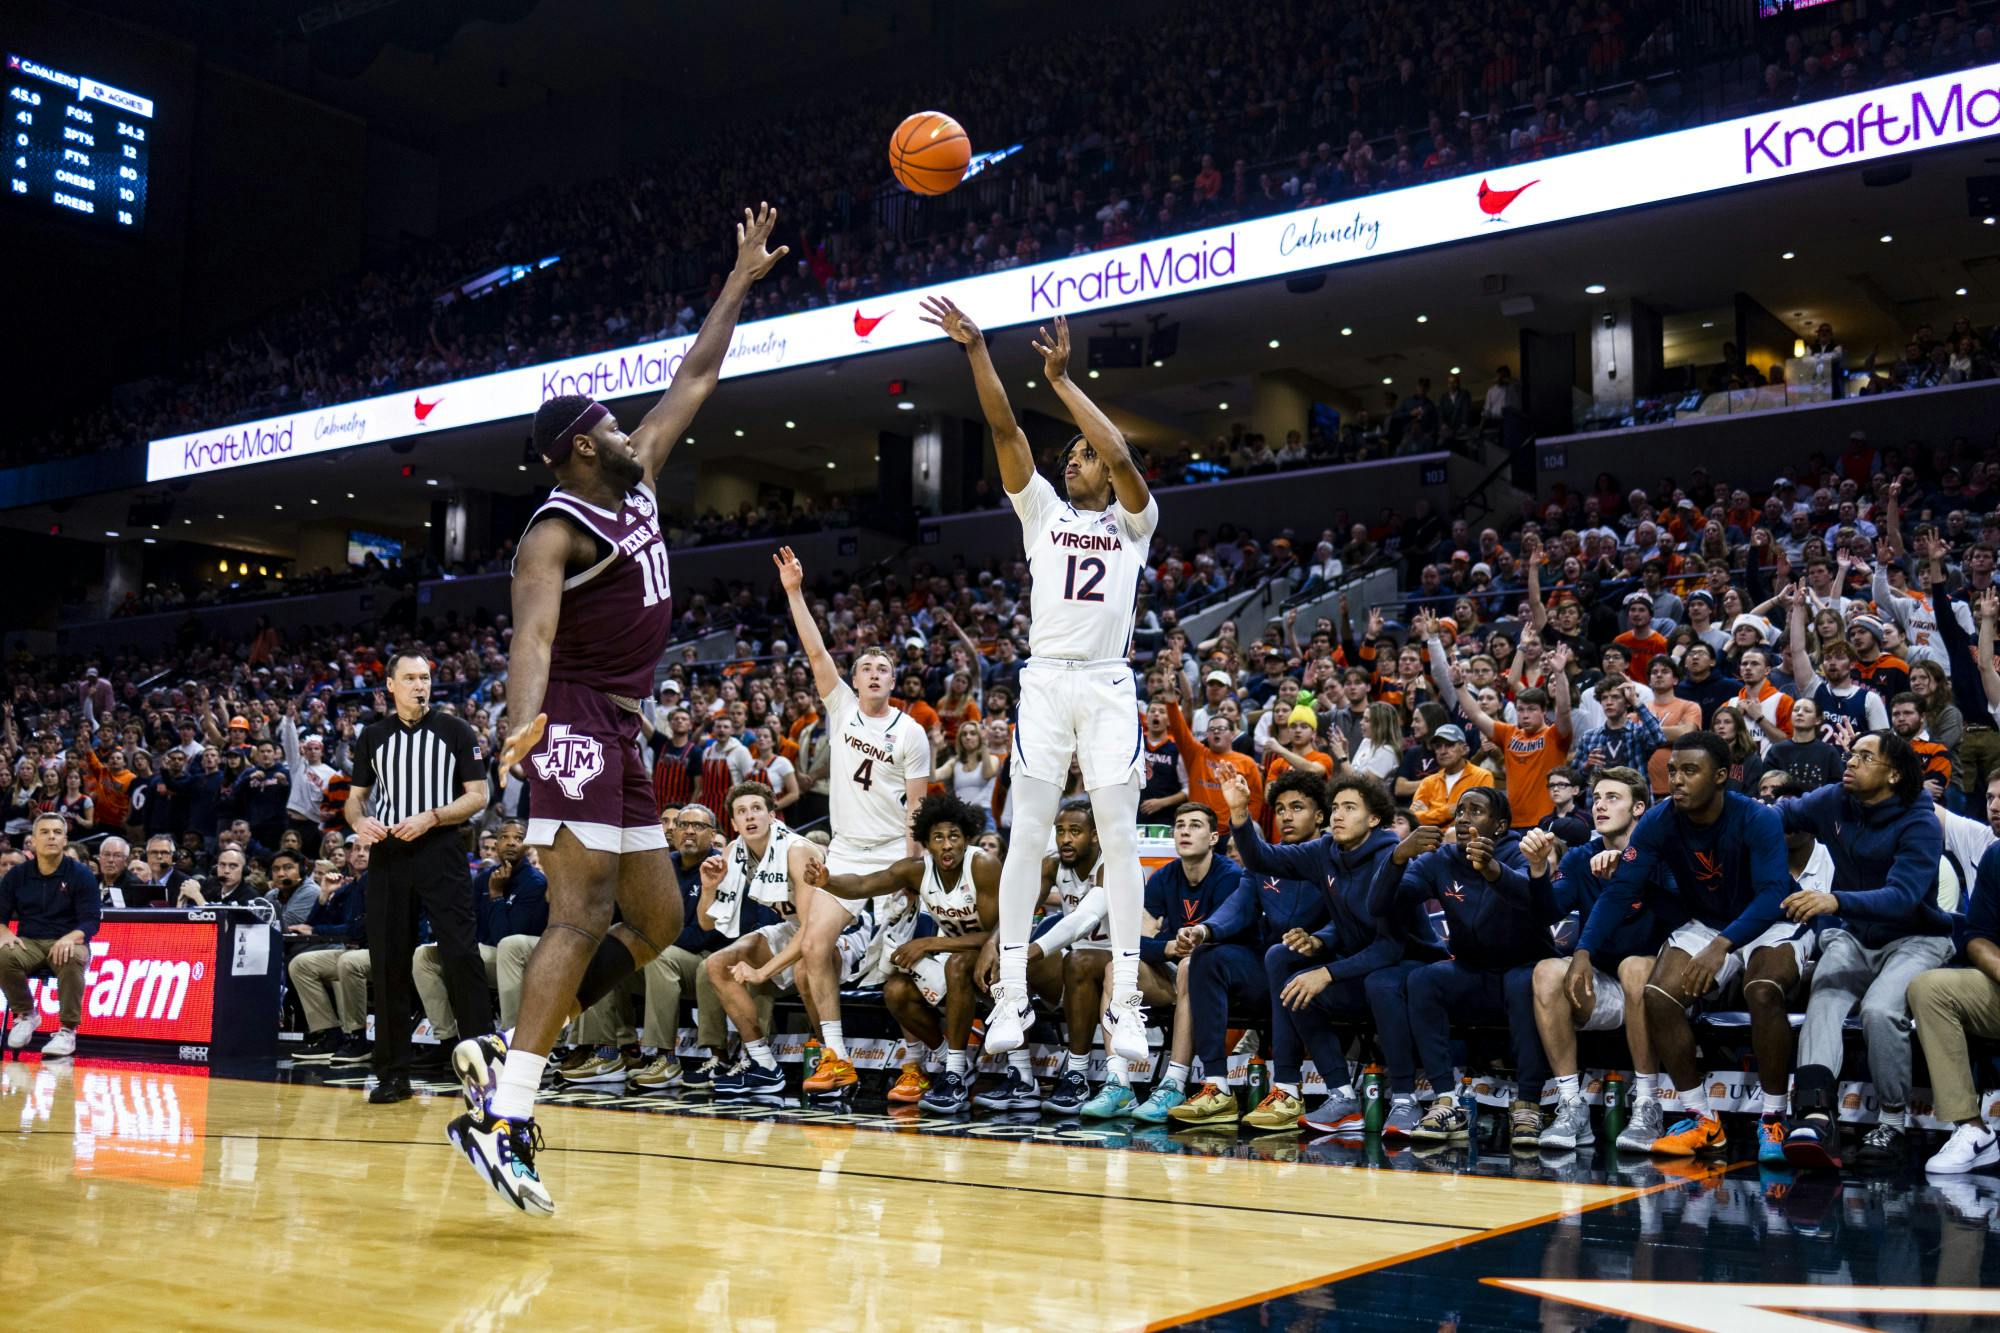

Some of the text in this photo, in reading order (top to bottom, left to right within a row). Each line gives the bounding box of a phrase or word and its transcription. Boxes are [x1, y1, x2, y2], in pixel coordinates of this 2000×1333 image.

[21, 60, 79, 89] CAVALIERS
[107, 92, 144, 111] AGGIES
[16, 111, 33, 125] 41
[66, 105, 93, 124] FG%
[17, 133, 29, 146] 0
[64, 127, 95, 147] 3PT%
[117, 122, 145, 141] 34.2
[65, 149, 90, 166] FT%
[123, 144, 137, 159] 12
[16, 156, 27, 168] 4
[55, 169, 96, 191] OREBS
[54, 192, 94, 213] DREBS
[120, 187, 135, 202] 10
[1030, 211, 1383, 313] KraftMaid Cabinetry
[727, 331, 787, 359] abinetry
[184, 411, 366, 470] KraftMaid Cabinetry
[1544, 456, 1564, 468] 104
[1426, 470, 1444, 482] 103
[619, 525, 652, 556] TEXAS
[1051, 531, 1122, 551] VIRGINIA
[635, 541, 671, 607] 10
[1064, 555, 1106, 602] 12
[1908, 618, 1938, 632] VIRGIN
[844, 733, 895, 765] VIRGINIA
[853, 759, 872, 791] 4
[188, 911, 216, 921] GEICO
[853, 1047, 884, 1061] Health
[1128, 1060, 1151, 1073] alth
[534, 1090, 1127, 1141] RTHOPEDICS
